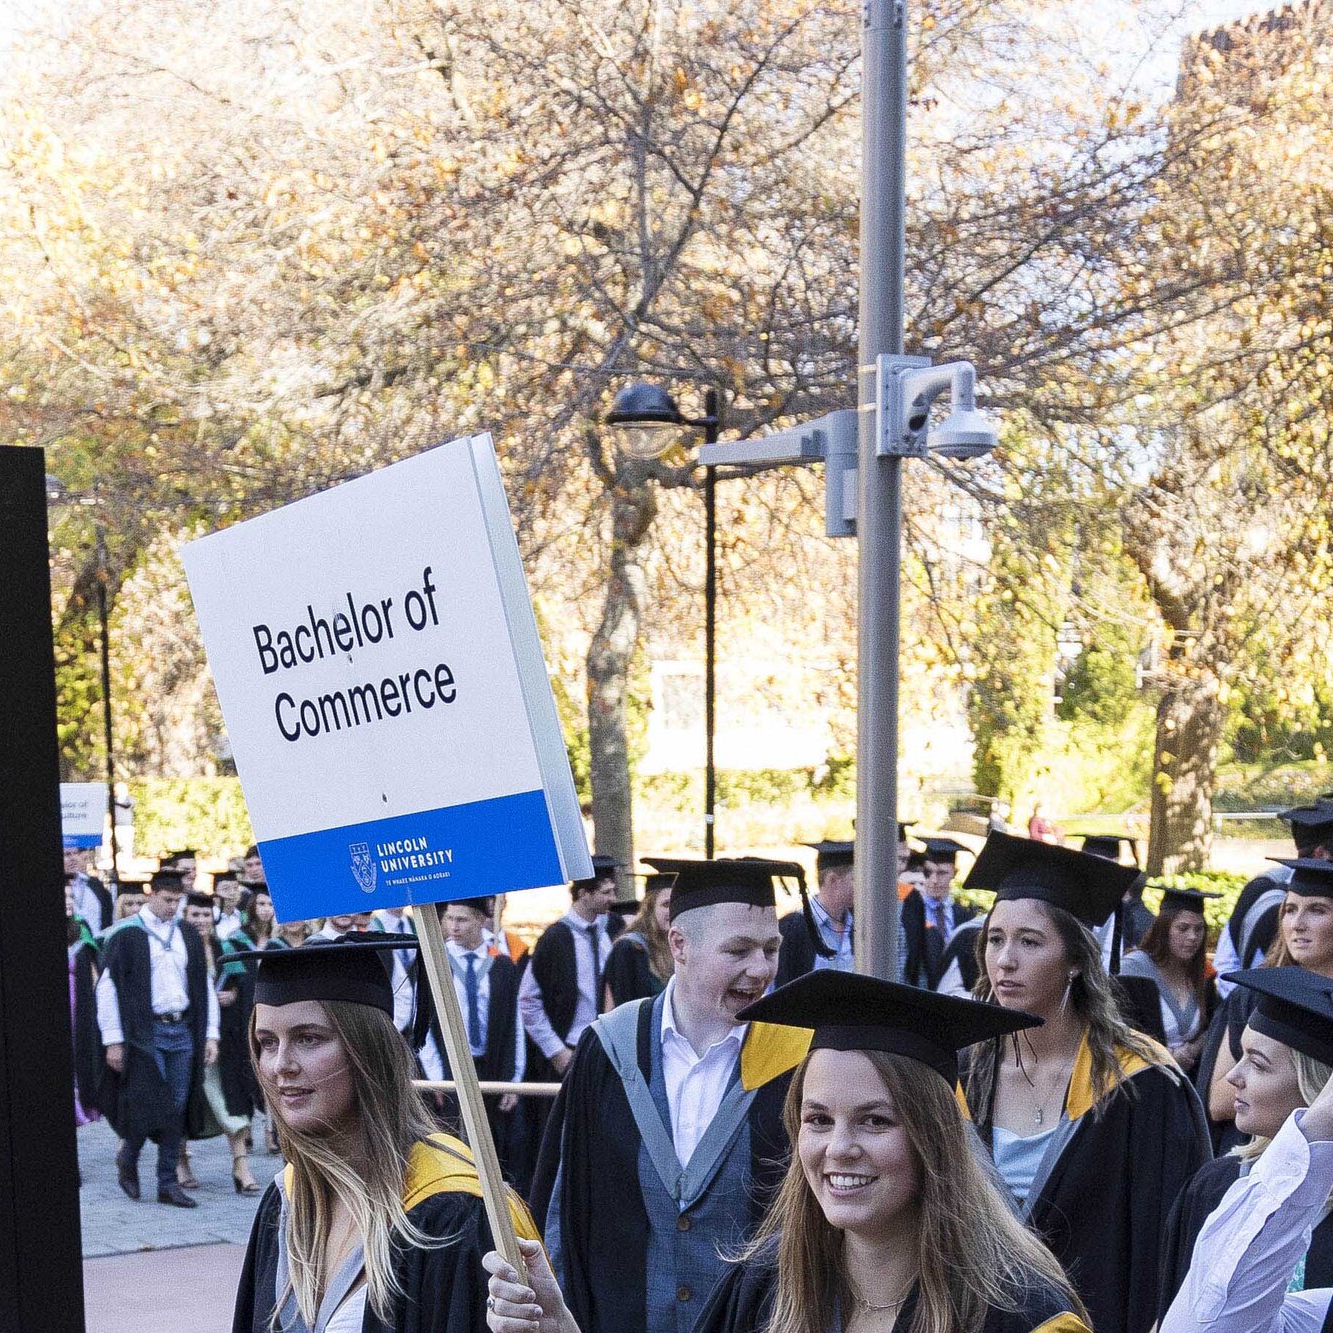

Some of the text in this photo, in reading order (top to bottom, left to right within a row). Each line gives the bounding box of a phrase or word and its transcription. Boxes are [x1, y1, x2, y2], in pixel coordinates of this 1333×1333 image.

[253, 566, 439, 675] Bachelor of
[275, 663, 457, 742] Commerce
[376, 836, 428, 857] LINCOLN
[380, 849, 453, 873] UNIVERSITY
